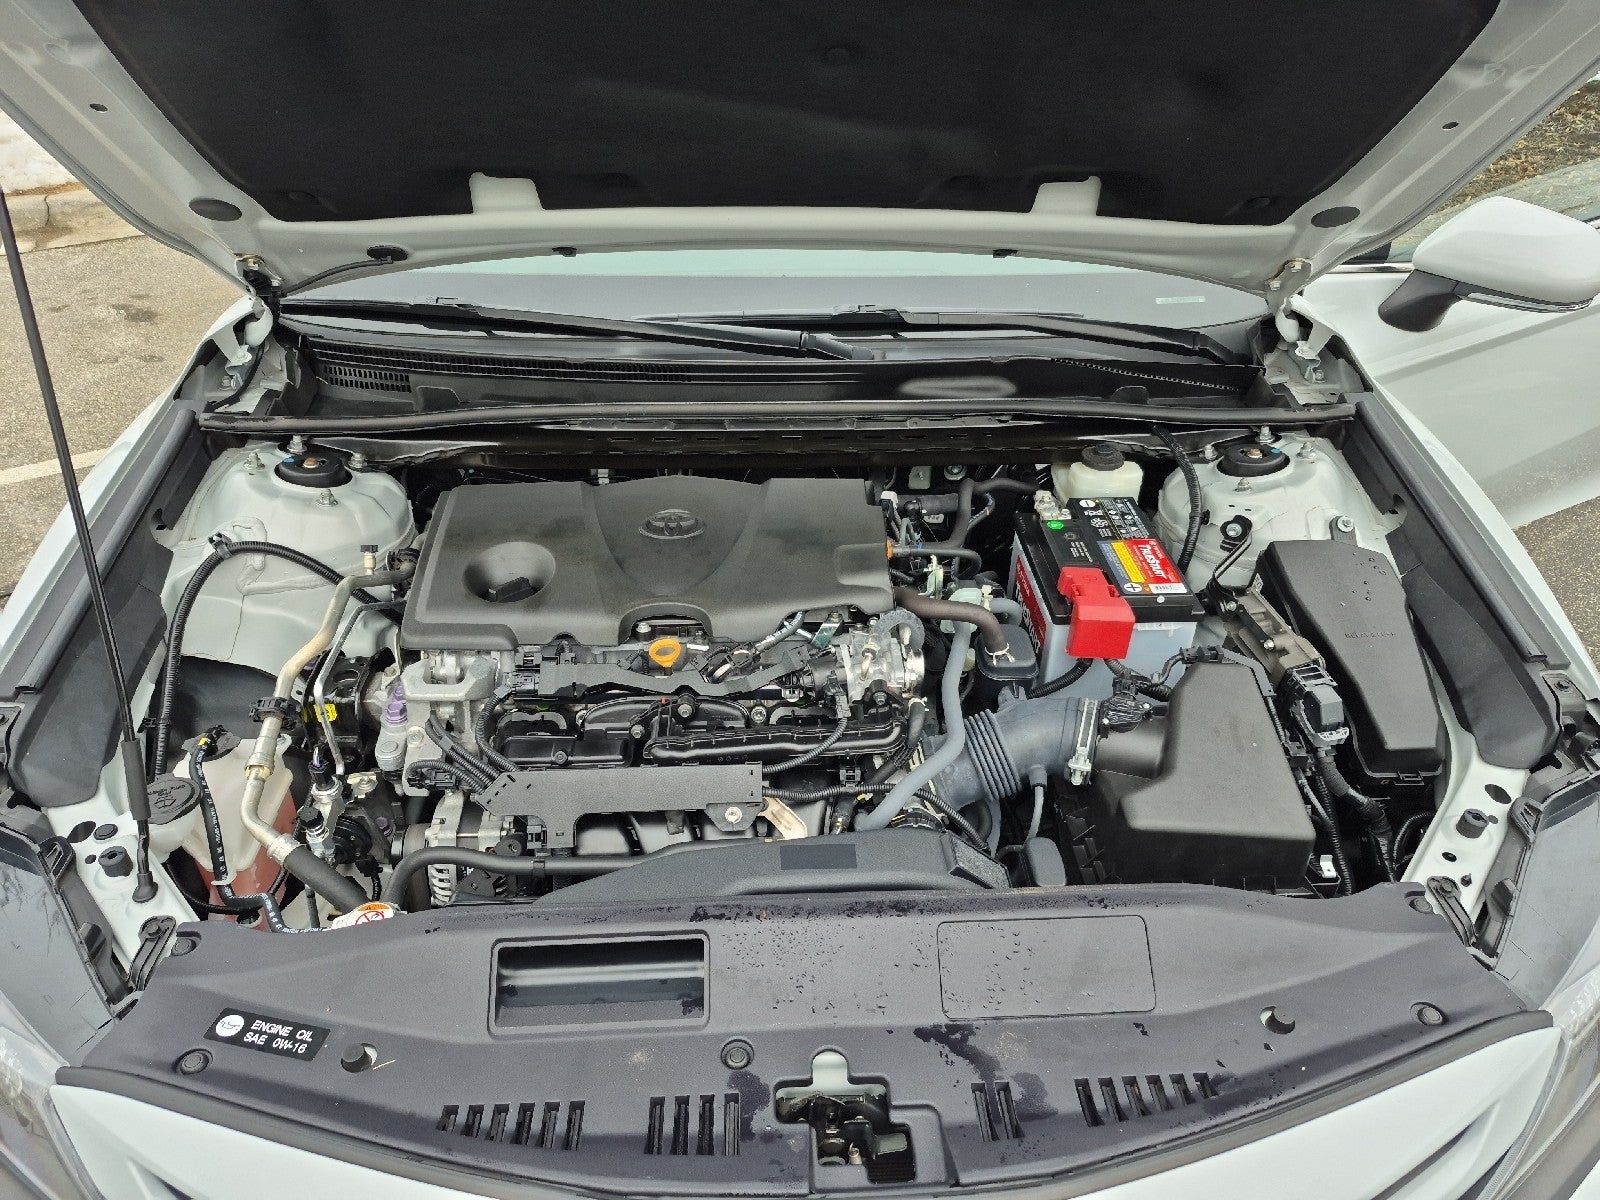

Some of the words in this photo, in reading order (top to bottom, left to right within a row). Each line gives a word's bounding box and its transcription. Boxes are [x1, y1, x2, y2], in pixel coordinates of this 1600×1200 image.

[250, 1020, 294, 1037] ENGINE
[296, 1030, 313, 1042] OIL
[243, 1032, 268, 1045] SAE
[272, 1038, 307, 1054] 0W-16
